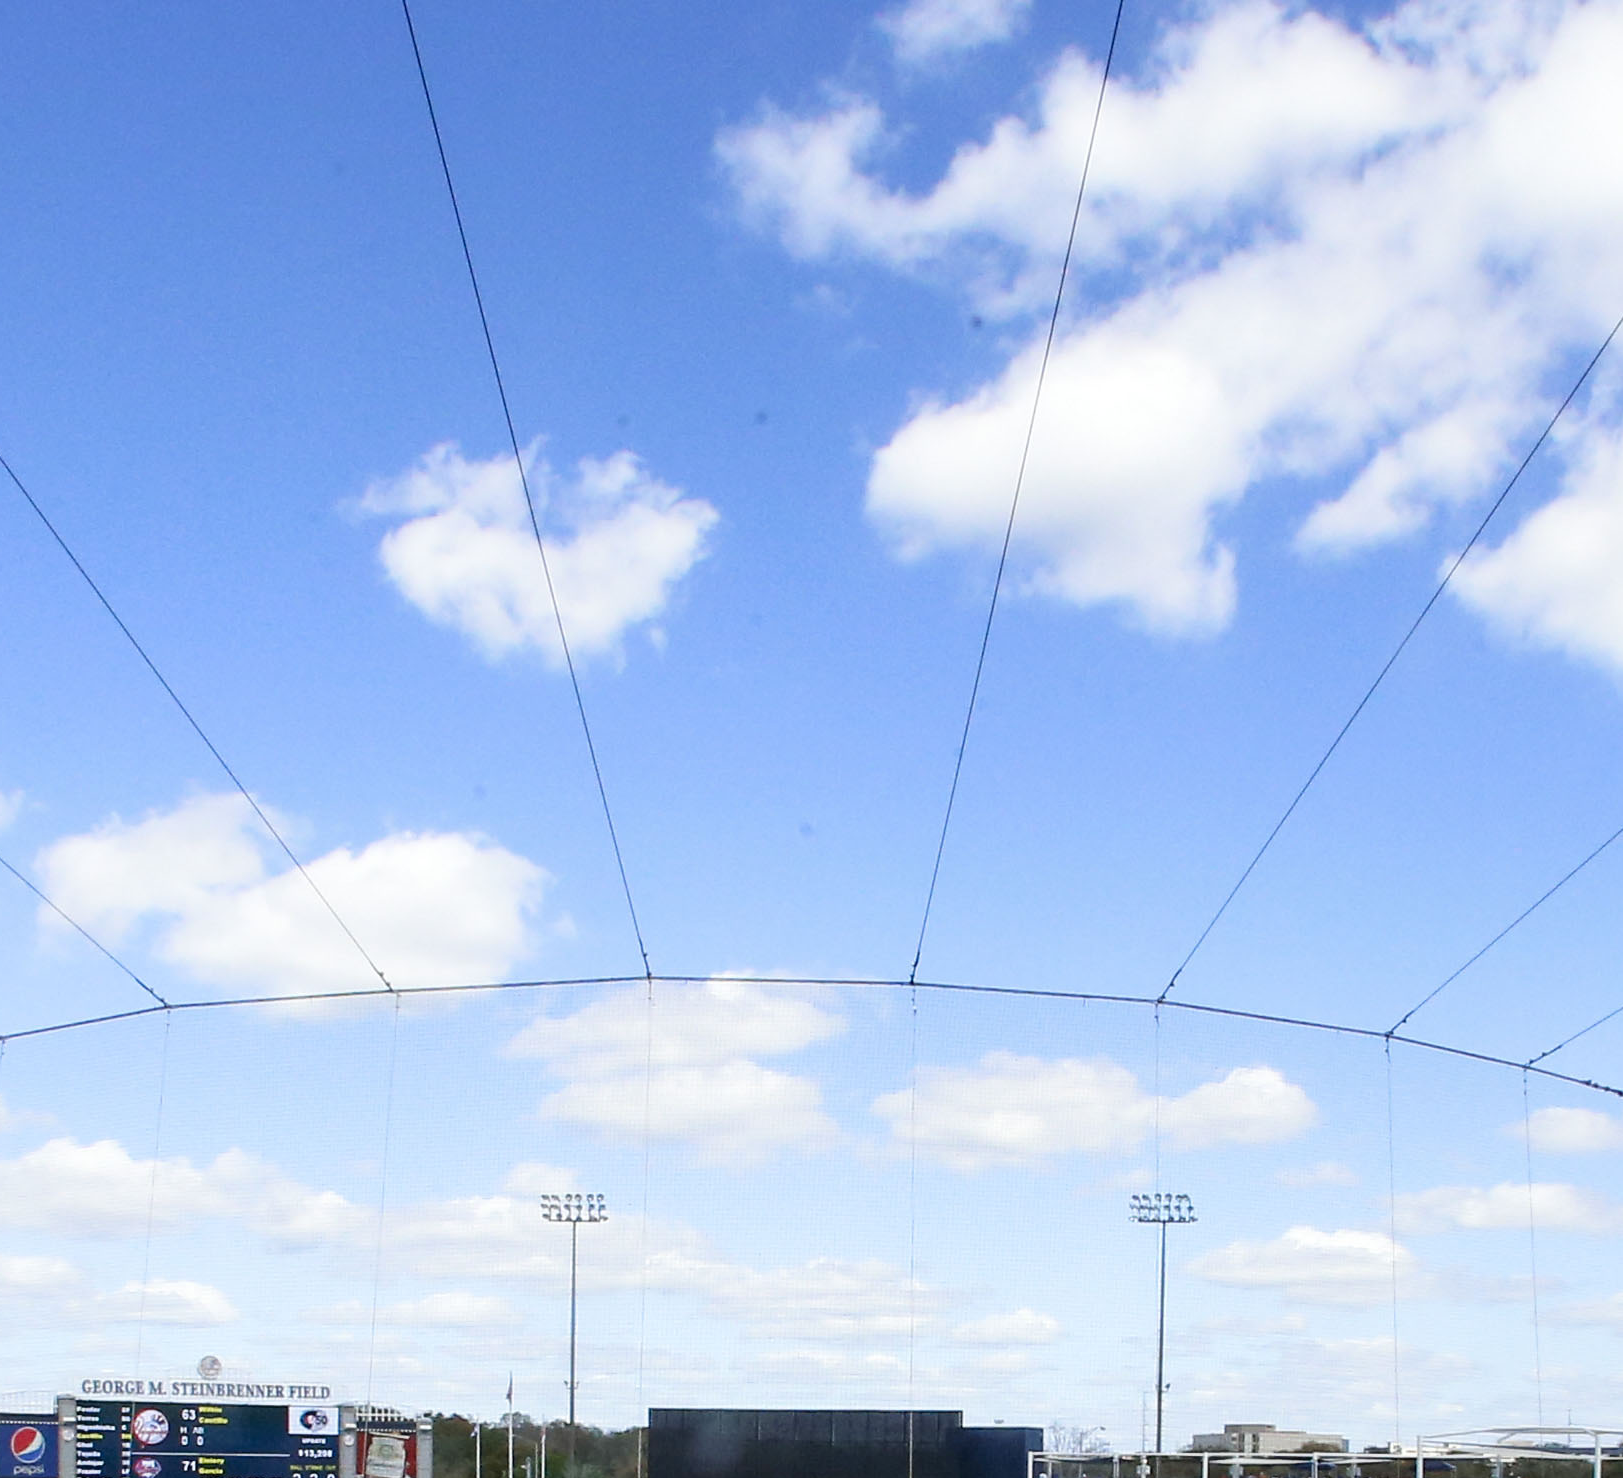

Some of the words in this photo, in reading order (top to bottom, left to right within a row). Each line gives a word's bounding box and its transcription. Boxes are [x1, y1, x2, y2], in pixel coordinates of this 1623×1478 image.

[82, 1380, 145, 1394] GEORGE
[148, 1381, 167, 1395] M.
[172, 1382, 284, 1398] STEINBRENNER
[289, 1386, 330, 1399] FIELD
[182, 1409, 196, 1420] 63
[181, 1436, 188, 1446] 0
[197, 1436, 204, 1446] 0
[13, 1464, 45, 1475] pepsi
[182, 1460, 196, 1471] 71
